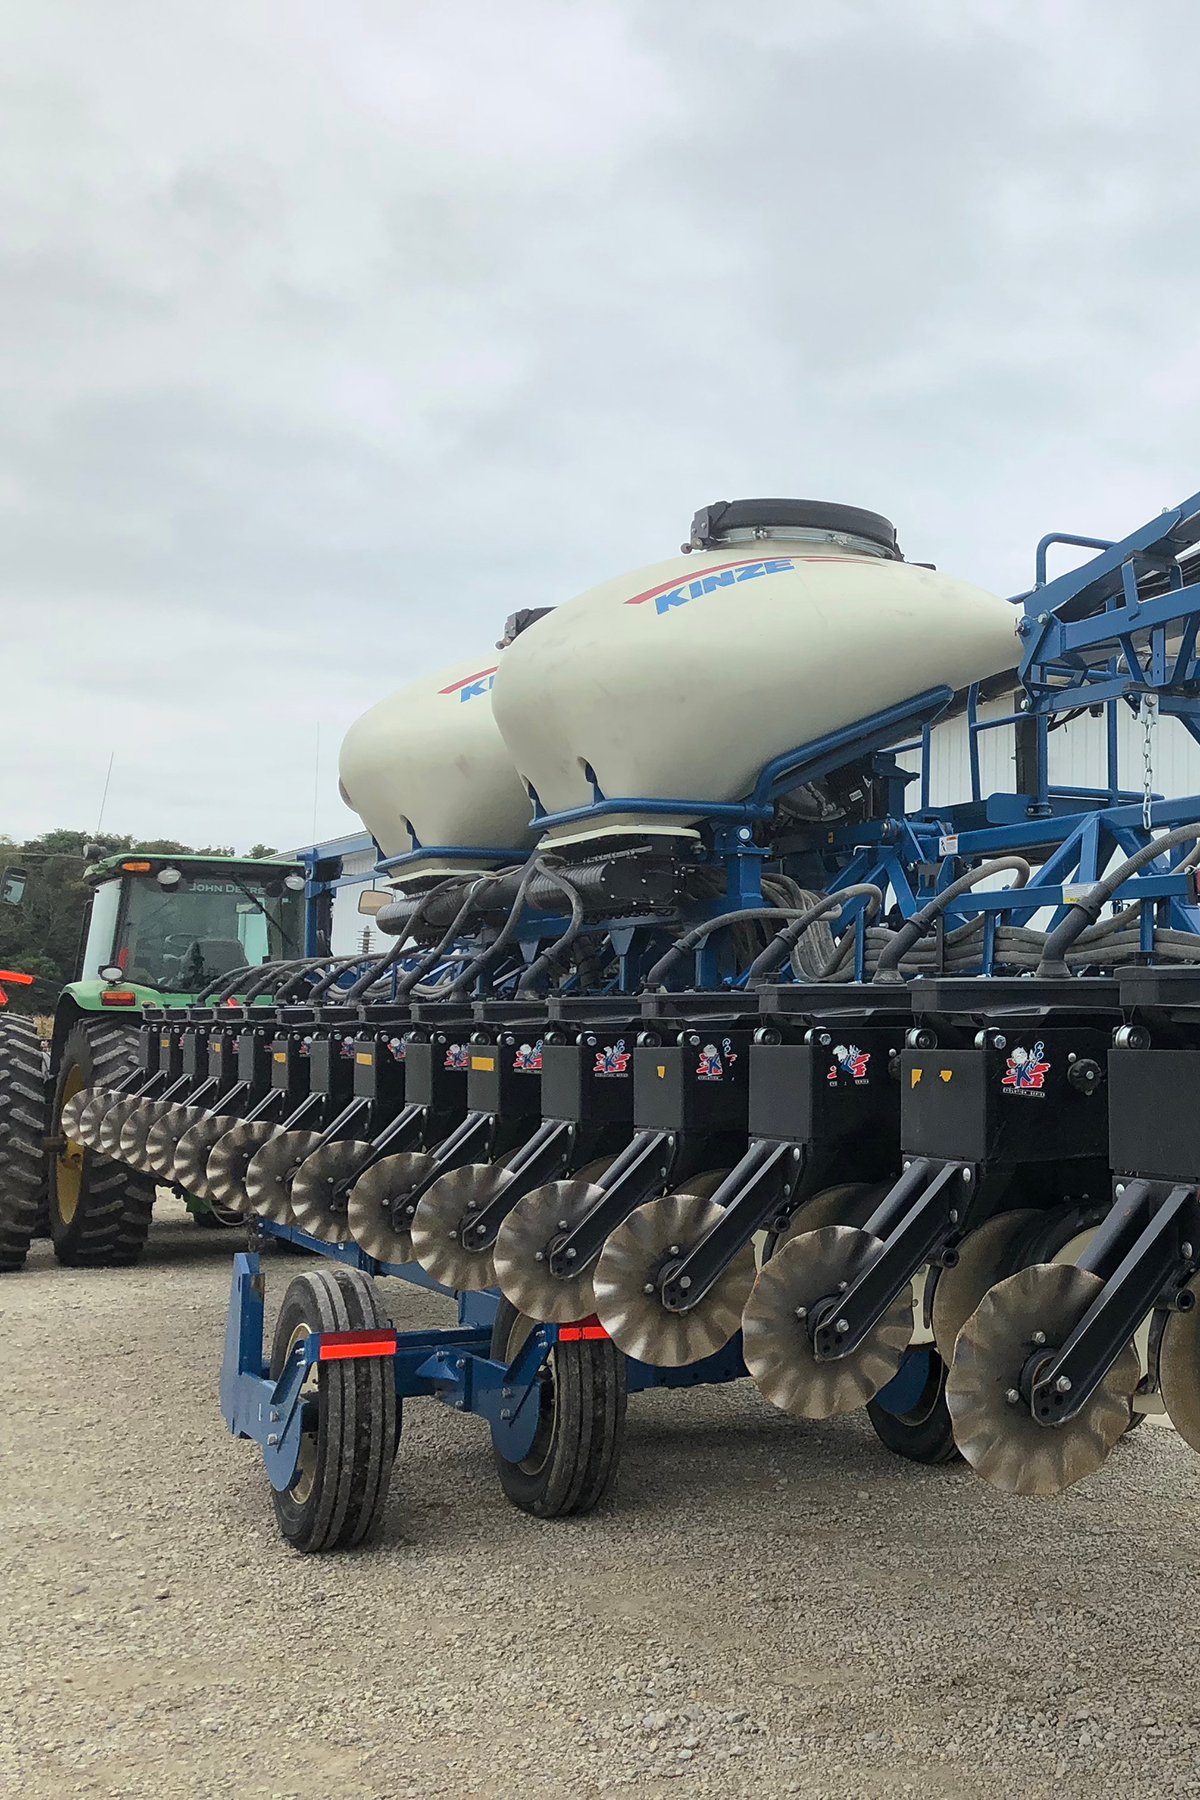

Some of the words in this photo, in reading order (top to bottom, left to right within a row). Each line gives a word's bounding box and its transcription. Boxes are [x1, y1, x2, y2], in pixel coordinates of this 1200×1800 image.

[655, 559, 795, 615] KINZE
[189, 883, 222, 892] JOHN
[225, 884, 266, 894] DERE
